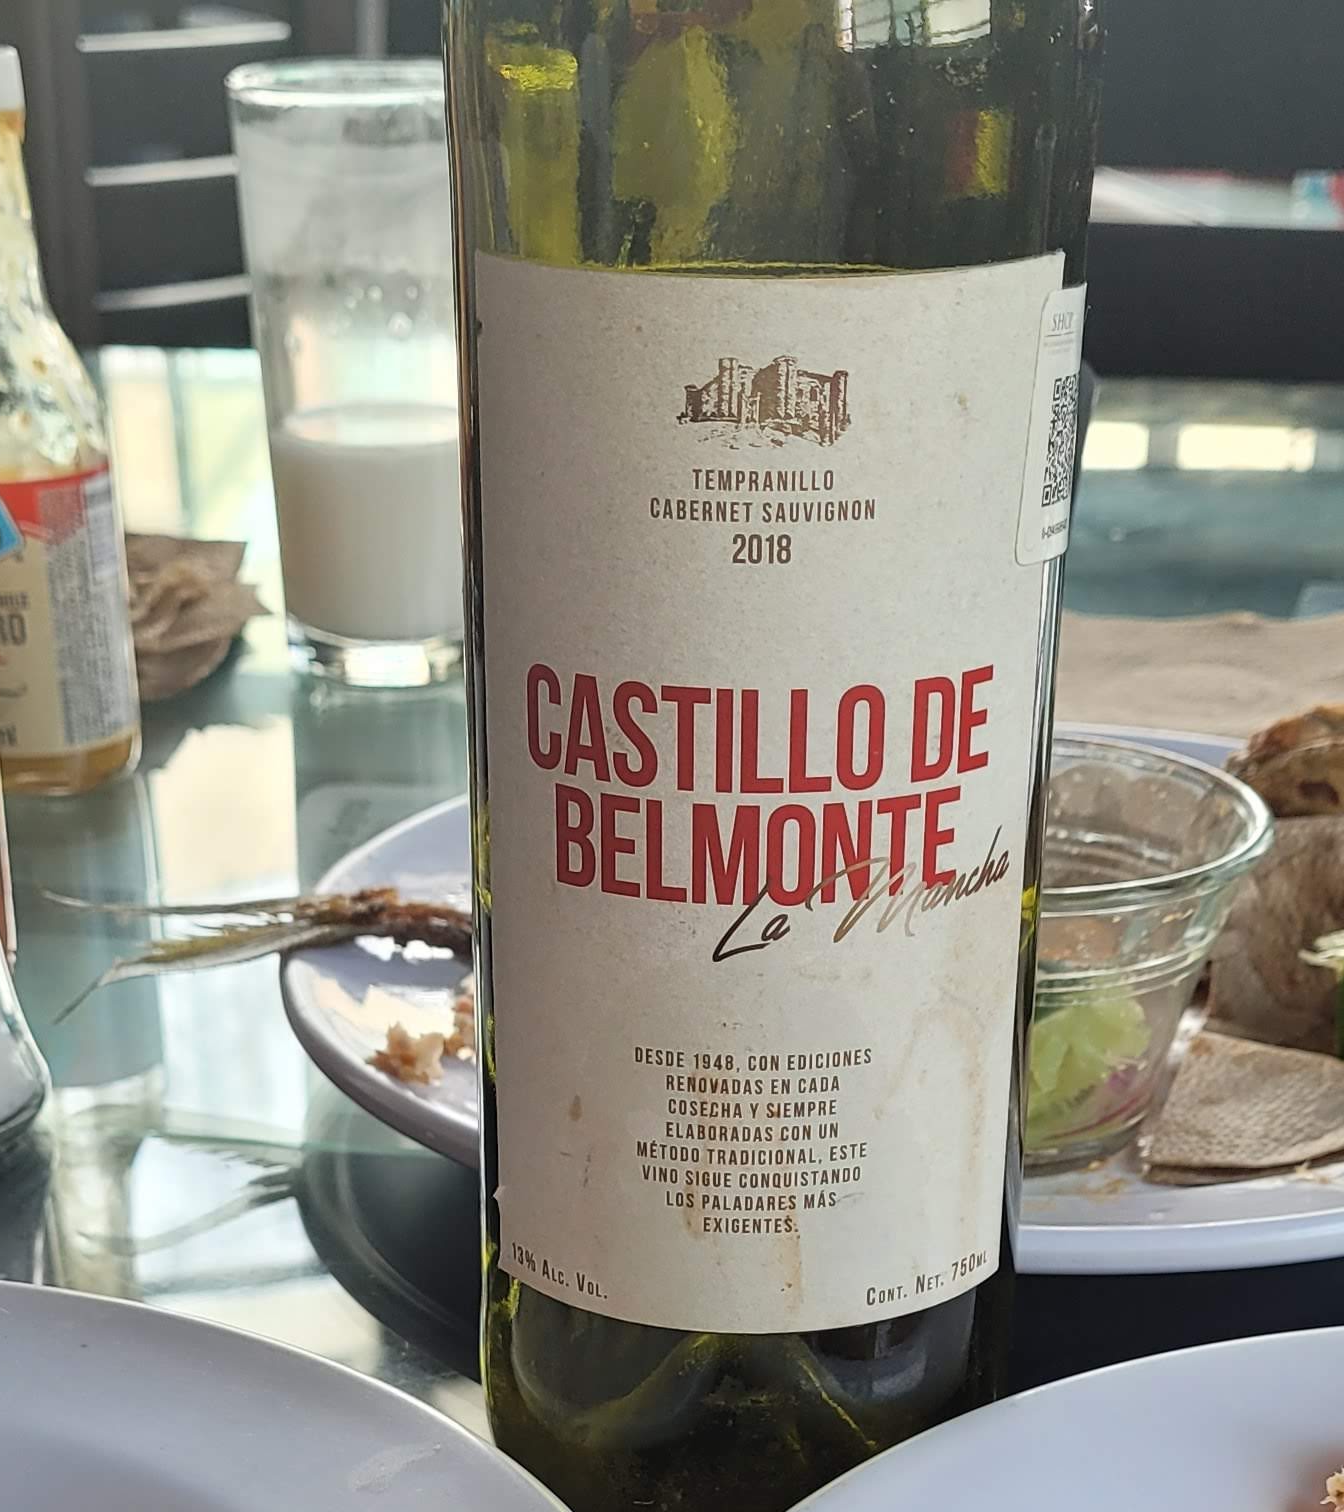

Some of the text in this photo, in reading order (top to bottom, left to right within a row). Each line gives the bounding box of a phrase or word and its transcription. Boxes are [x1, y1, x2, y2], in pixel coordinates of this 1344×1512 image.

[692, 468, 834, 492] TEMPRANILLO
[649, 497, 876, 523] CABERNET SAUVIGNON
[732, 533, 792, 564] 2018
[525, 663, 995, 794] CASTILLO DE
[555, 785, 962, 907] BELMONTE
[712, 824, 1010, 963] La Mancha
[634, 1047, 872, 1073] DESDE 1948, CON EDICIONES
[666, 1075, 841, 1095] RENOVADAS EN CADA
[668, 1098, 838, 1119] COSECHA Y SIEMPRE
[666, 1121, 839, 1142] ELABORADAS CON UN
[636, 1139, 868, 1166] MÉTODO TRADICIONAL, ESTE
[641, 1165, 862, 1189] VINO SIGUE CONQUISTANDO
[666, 1189, 838, 1212] LOS PALADARES MÁS
[703, 1216, 800, 1234] EXIGENTES.
[512, 1242, 536, 1273] 13%
